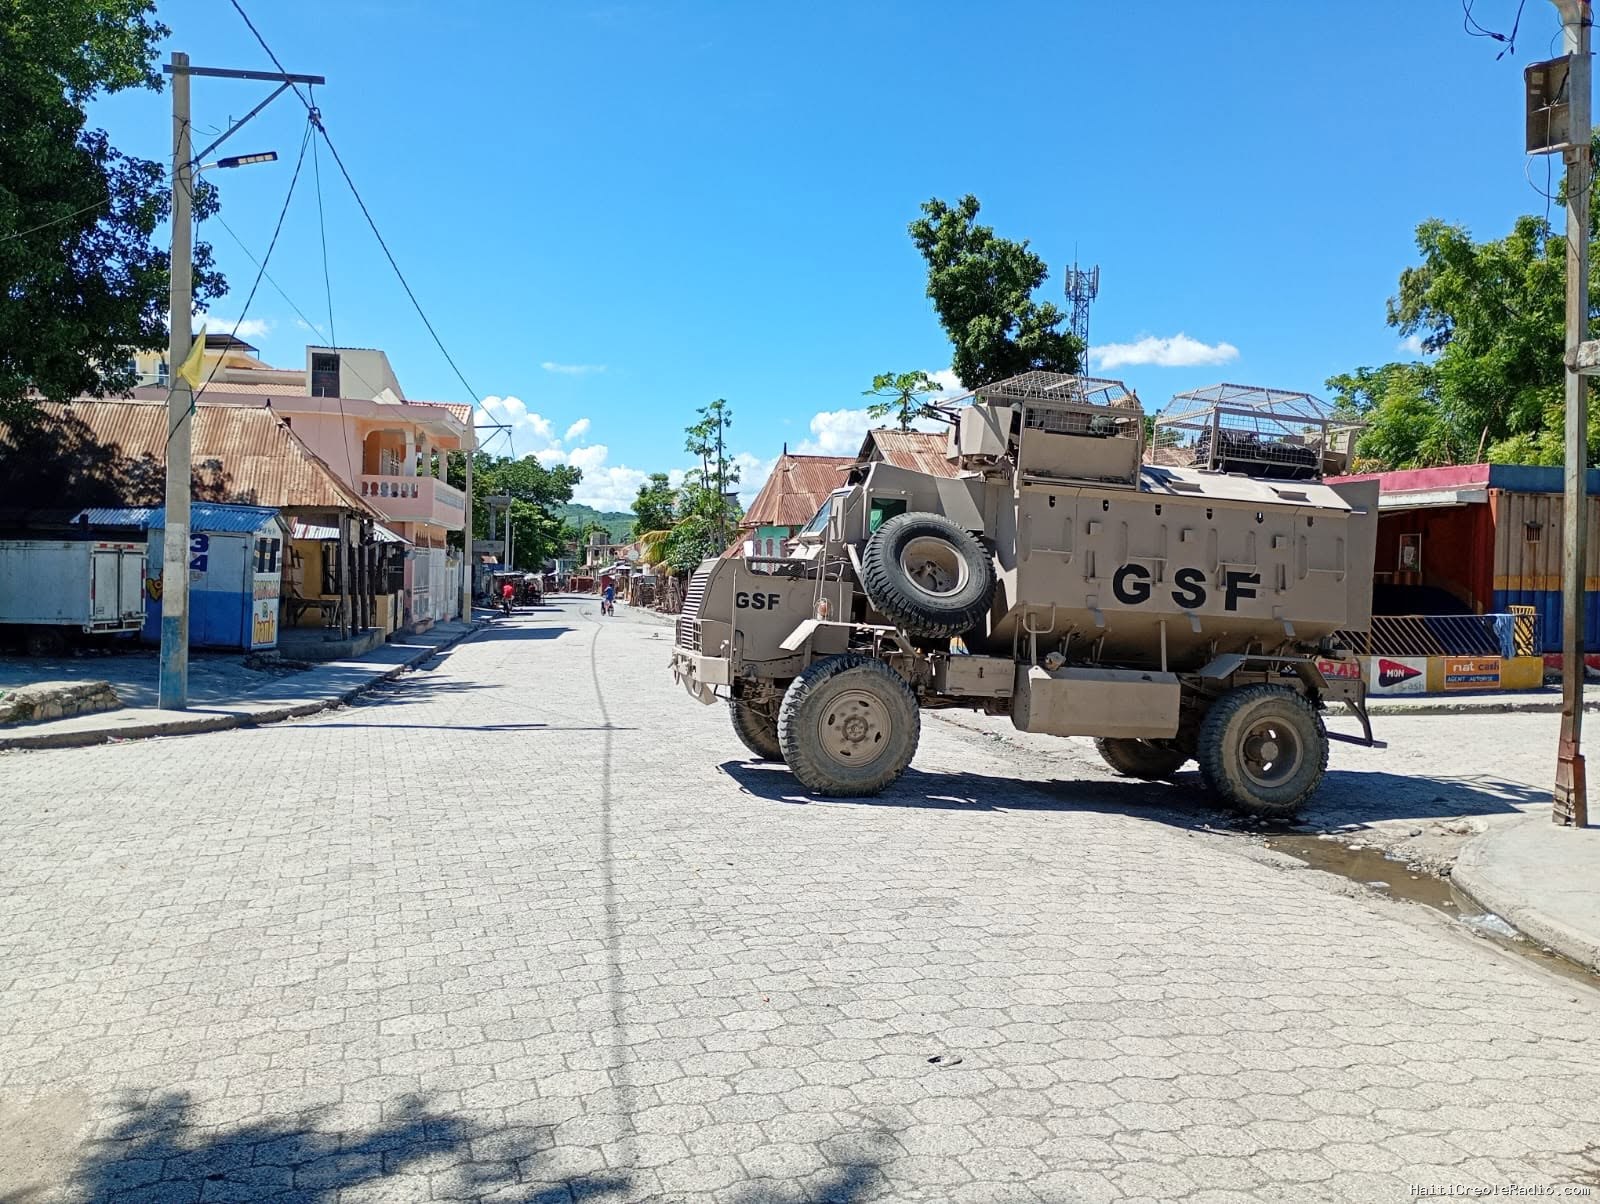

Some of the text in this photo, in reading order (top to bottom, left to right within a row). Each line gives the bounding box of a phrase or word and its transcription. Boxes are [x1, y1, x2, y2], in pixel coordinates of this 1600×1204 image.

[1112, 563, 1261, 611] GSF
[736, 591, 781, 610] GSF
[1453, 661, 1474, 671] nat
[1386, 669, 1406, 678] MON
